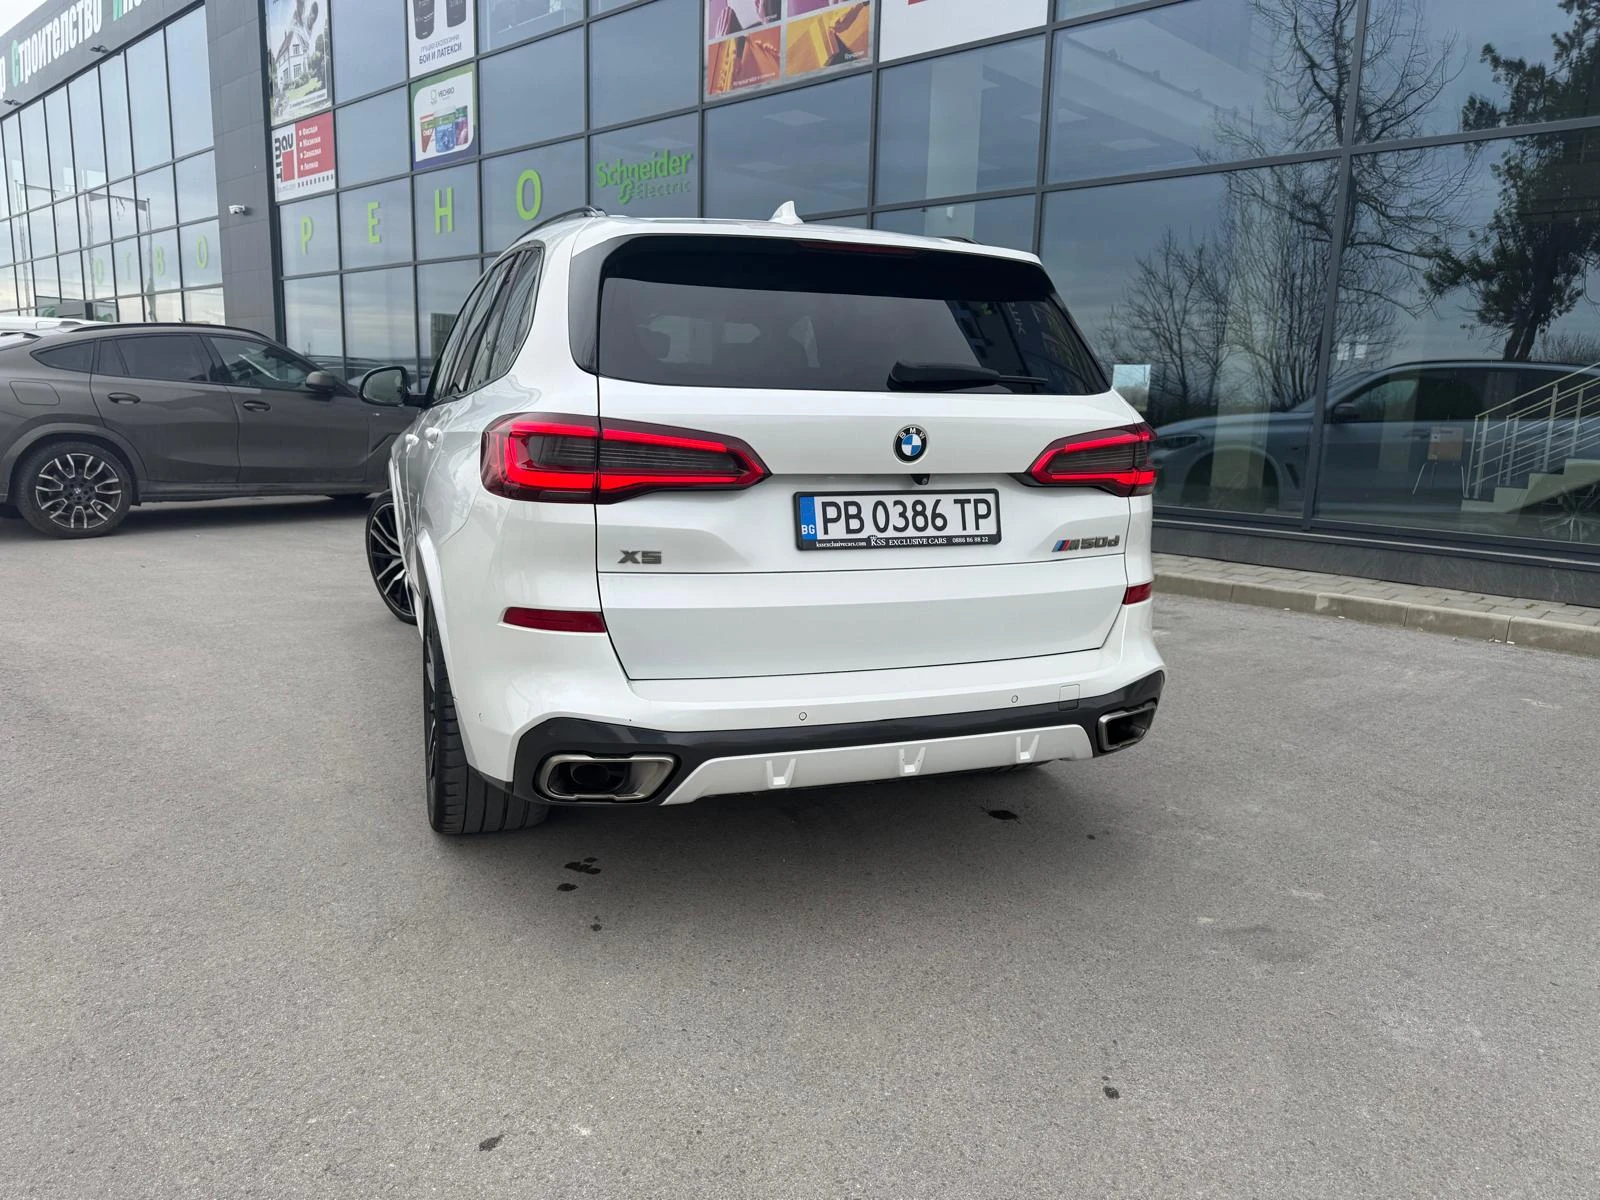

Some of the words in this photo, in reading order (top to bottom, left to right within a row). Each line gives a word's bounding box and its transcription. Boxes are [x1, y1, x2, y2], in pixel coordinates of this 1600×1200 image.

[596, 149, 693, 187] Schneider
[898, 427, 926, 440] BMW
[821, 501, 865, 535] PB
[872, 499, 948, 533] 0386
[953, 498, 992, 531] TP
[801, 524, 816, 535] BG
[871, 538, 886, 547] KSS
[889, 537, 928, 546] EXCLUSIVE
[929, 537, 947, 545] CARS
[617, 550, 662, 564] X5
